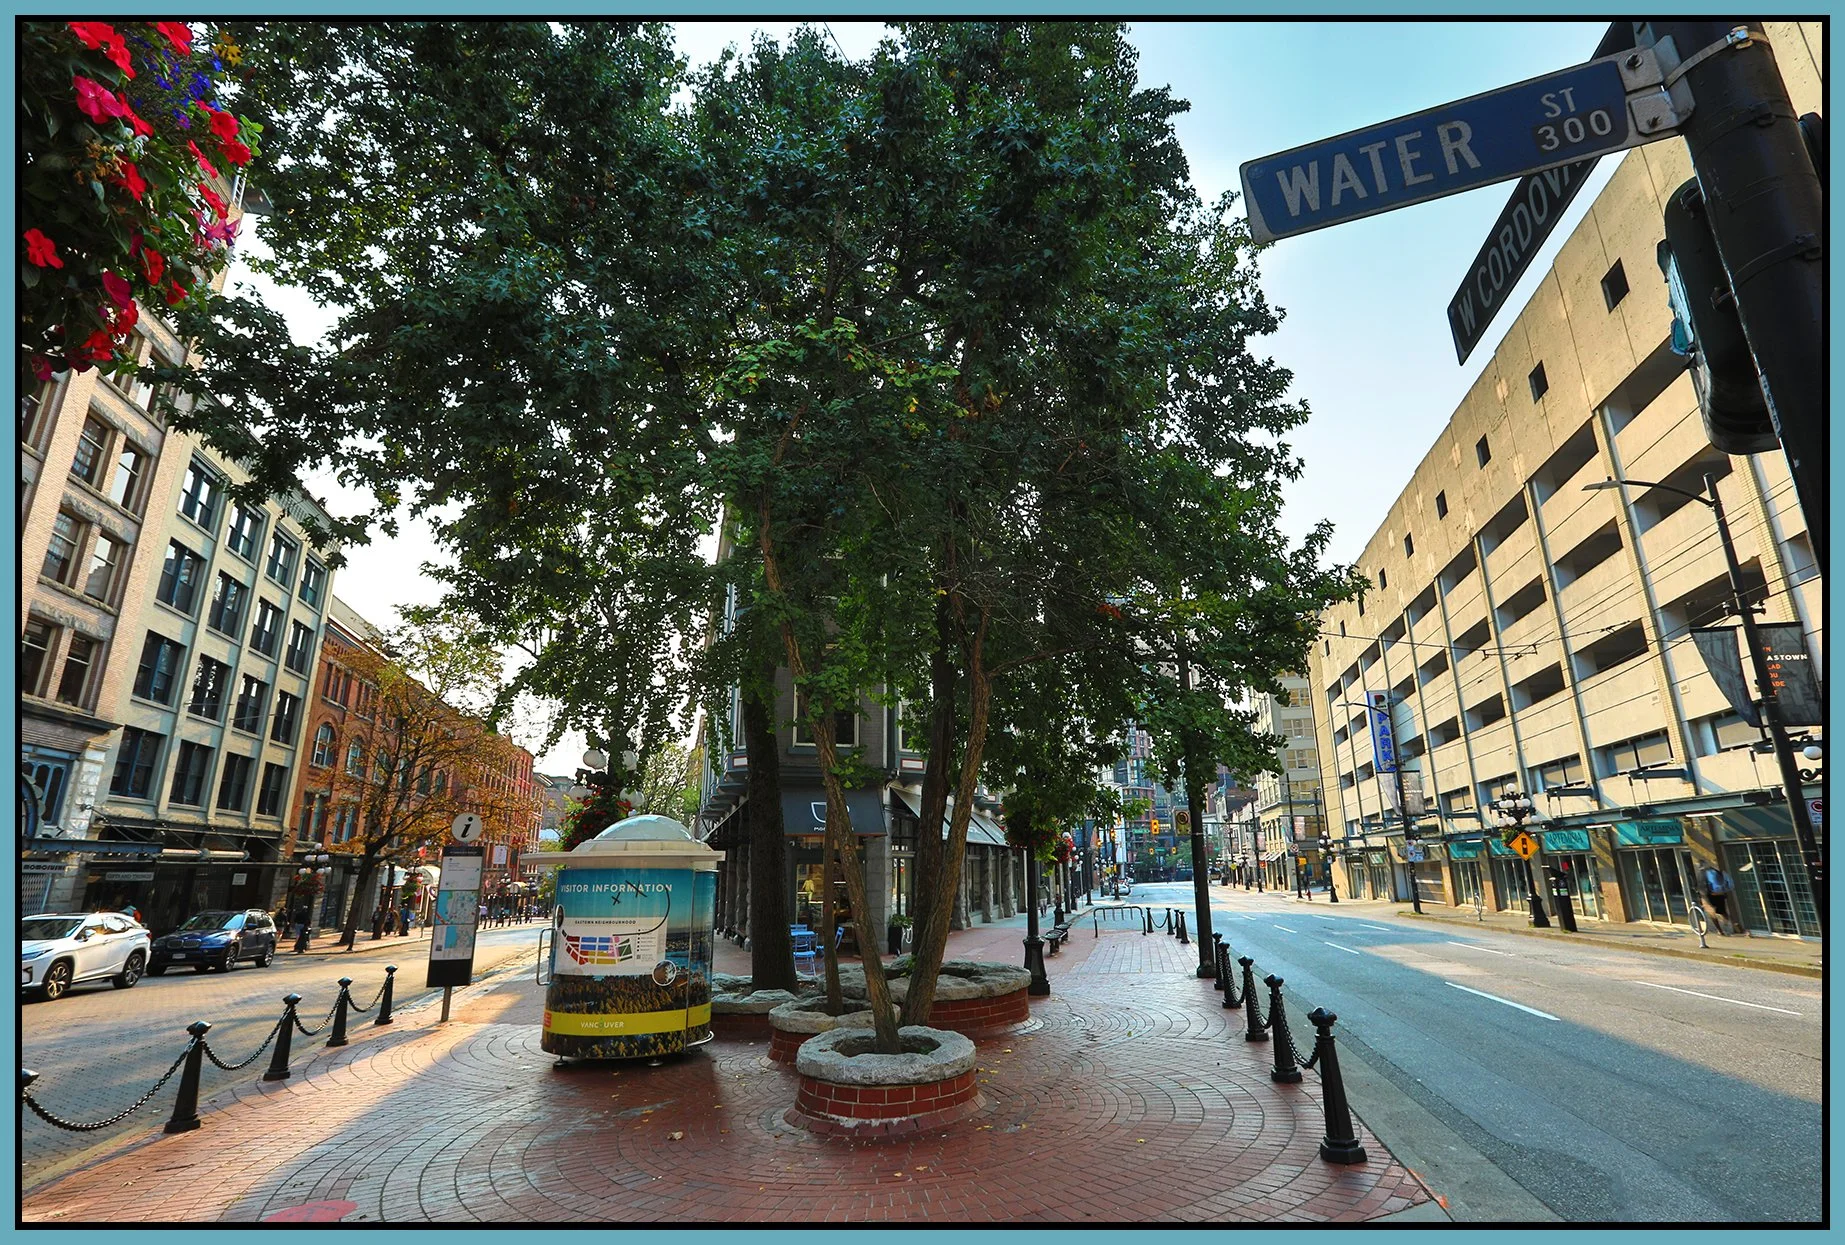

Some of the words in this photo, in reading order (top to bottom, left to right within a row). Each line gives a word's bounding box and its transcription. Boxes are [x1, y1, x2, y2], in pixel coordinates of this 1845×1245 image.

[1540, 86, 1576, 119] ST
[1537, 109, 1613, 153] 300
[1275, 119, 1482, 218] WATER
[1458, 287, 1477, 337] W
[1376, 712, 1394, 762] PARK
[561, 884, 589, 893] VISITOR
[592, 883, 673, 893] INFORMATION
